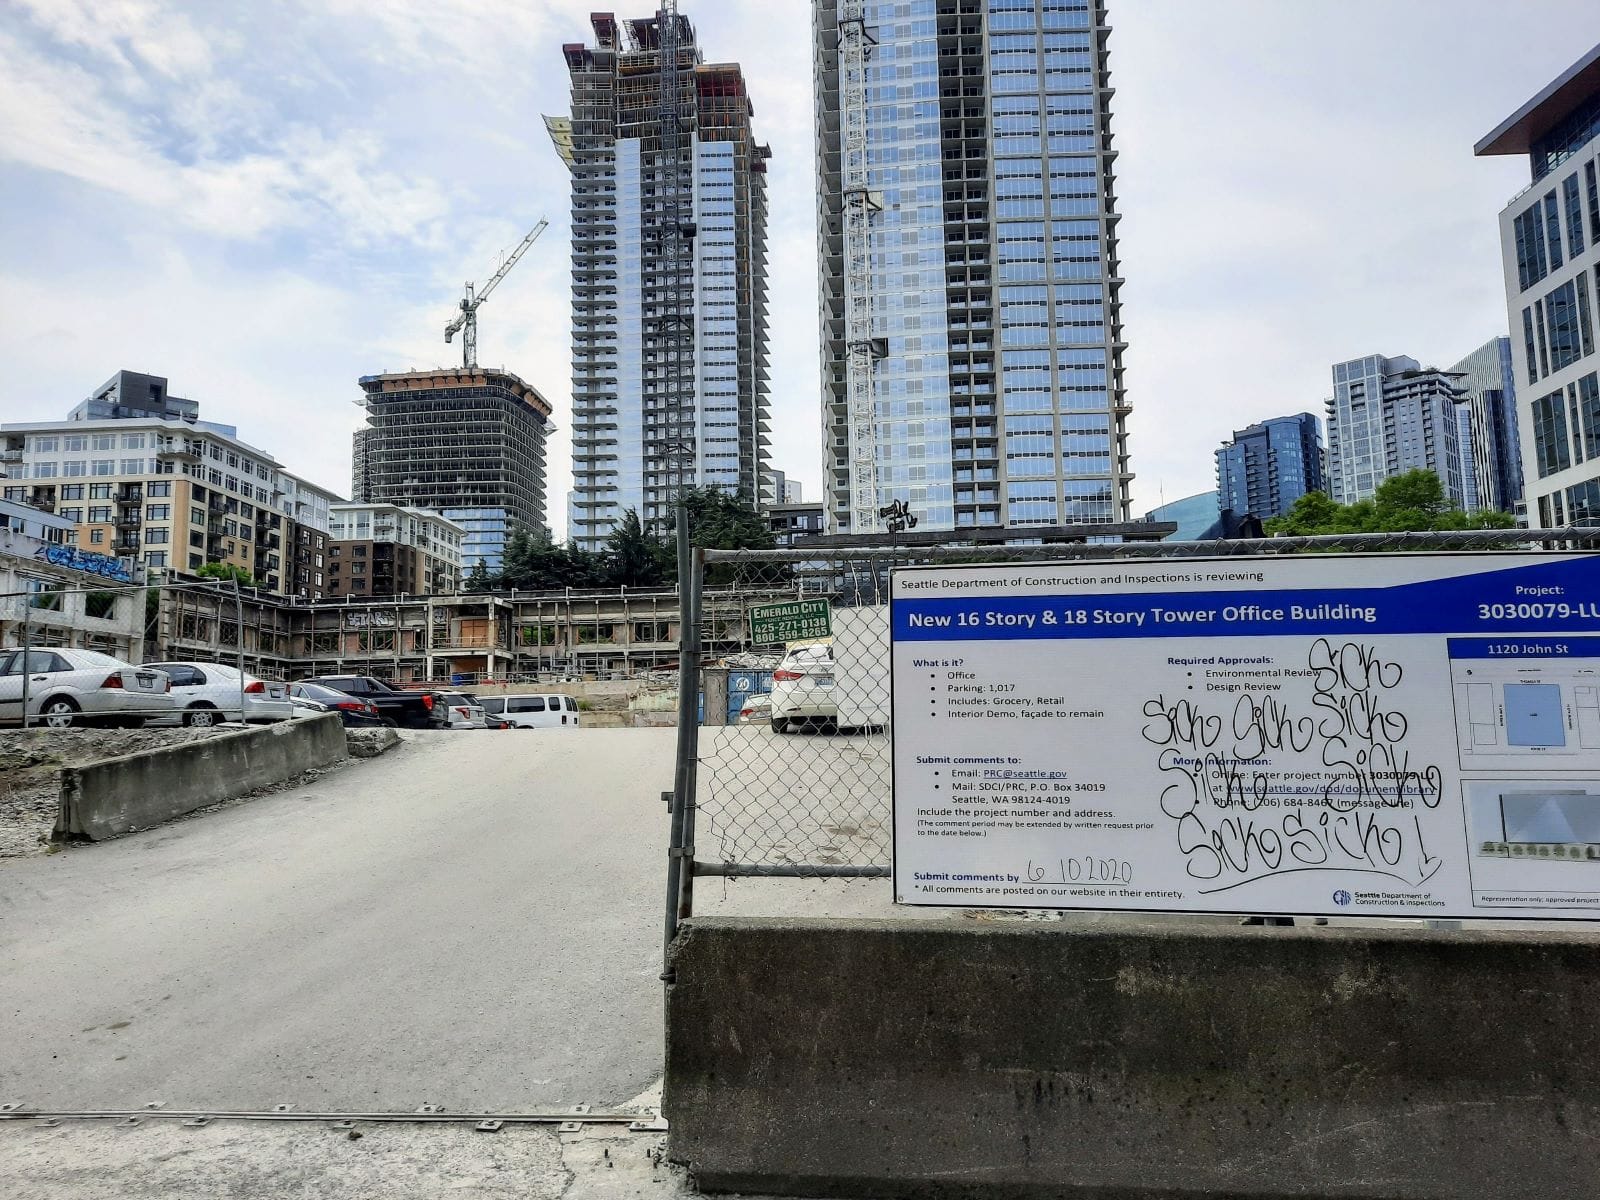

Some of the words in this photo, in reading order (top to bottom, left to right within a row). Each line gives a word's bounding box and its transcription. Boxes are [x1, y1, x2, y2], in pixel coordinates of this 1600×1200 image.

[902, 580, 938, 589] Seattle
[942, 579, 1007, 589] Department
[1011, 578, 1021, 586] of
[1025, 576, 1096, 585] Construction
[1101, 575, 1121, 584] and
[1125, 574, 1190, 585] Inspections
[1194, 573, 1202, 581] is
[1207, 572, 1263, 583] reviewing
[1516, 586, 1564, 596] Project:
[909, 613, 951, 627] New
[958, 612, 979, 625] 16
[986, 611, 1035, 628] Story
[1042, 611, 1057, 624] &
[1065, 610, 1087, 624] 18
[1094, 609, 1145, 627] Story
[1151, 608, 1216, 622] Tower
[1223, 606, 1283, 621] Office
[1291, 604, 1376, 622] Building
[754, 618, 827, 633] 425-271-0138
[1488, 645, 1518, 653] 1120
[1522, 644, 1551, 653] John
[1556, 645, 1568, 653] St
[913, 659, 939, 667] What
[1168, 657, 1214, 666] Required
[1218, 656, 1273, 665] Approvals:
[1206, 669, 1281, 677] Environmental
[1284, 668, 1322, 677] Review
[948, 685, 985, 693] Parking:
[990, 684, 1015, 693] 1,017
[1207, 684, 1240, 692] Design
[949, 697, 990, 705] Includes:
[993, 697, 1033, 706] Grocery,
[1037, 697, 1064, 705] Retail
[987, 710, 1017, 719] Demo,
[1021, 710, 1053, 719] façade
[1205, 757, 1272, 766] nformation:
[984, 770, 1067, 779] PRC@seattle.gov
[1212, 770, 1249, 779] Onlne:
[1253, 770, 1280, 779] Enter
[1284, 770, 1320, 782] project
[1370, 772, 1434, 780] 3030079LU
[953, 783, 975, 791] Mail:
[979, 783, 1027, 792] SDCI/PRC,
[1212, 784, 1222, 793] at
[953, 796, 988, 805] Seattle,
[992, 796, 1009, 804] WA
[1012, 796, 1070, 804] 98124-4019
[1214, 798, 1250, 806] Phn:
[1284, 798, 1332, 807] 684-8467
[1338, 798, 1386, 809] (message
[1390, 798, 1414, 809] lie)
[955, 808, 970, 816] the
[974, 810, 1008, 818] project
[1012, 809, 1049, 817] number
[1053, 809, 1070, 817] and
[1086, 856, 1132, 884] 2020
[914, 872, 949, 880] Submit
[952, 873, 1004, 881] comments
[1007, 874, 1019, 883] by
[923, 885, 933, 893] All
[1003, 887, 1034, 897] posted
[1070, 888, 1105, 896] website
[1120, 889, 1142, 897] their
[1145, 890, 1184, 899] entirety.
